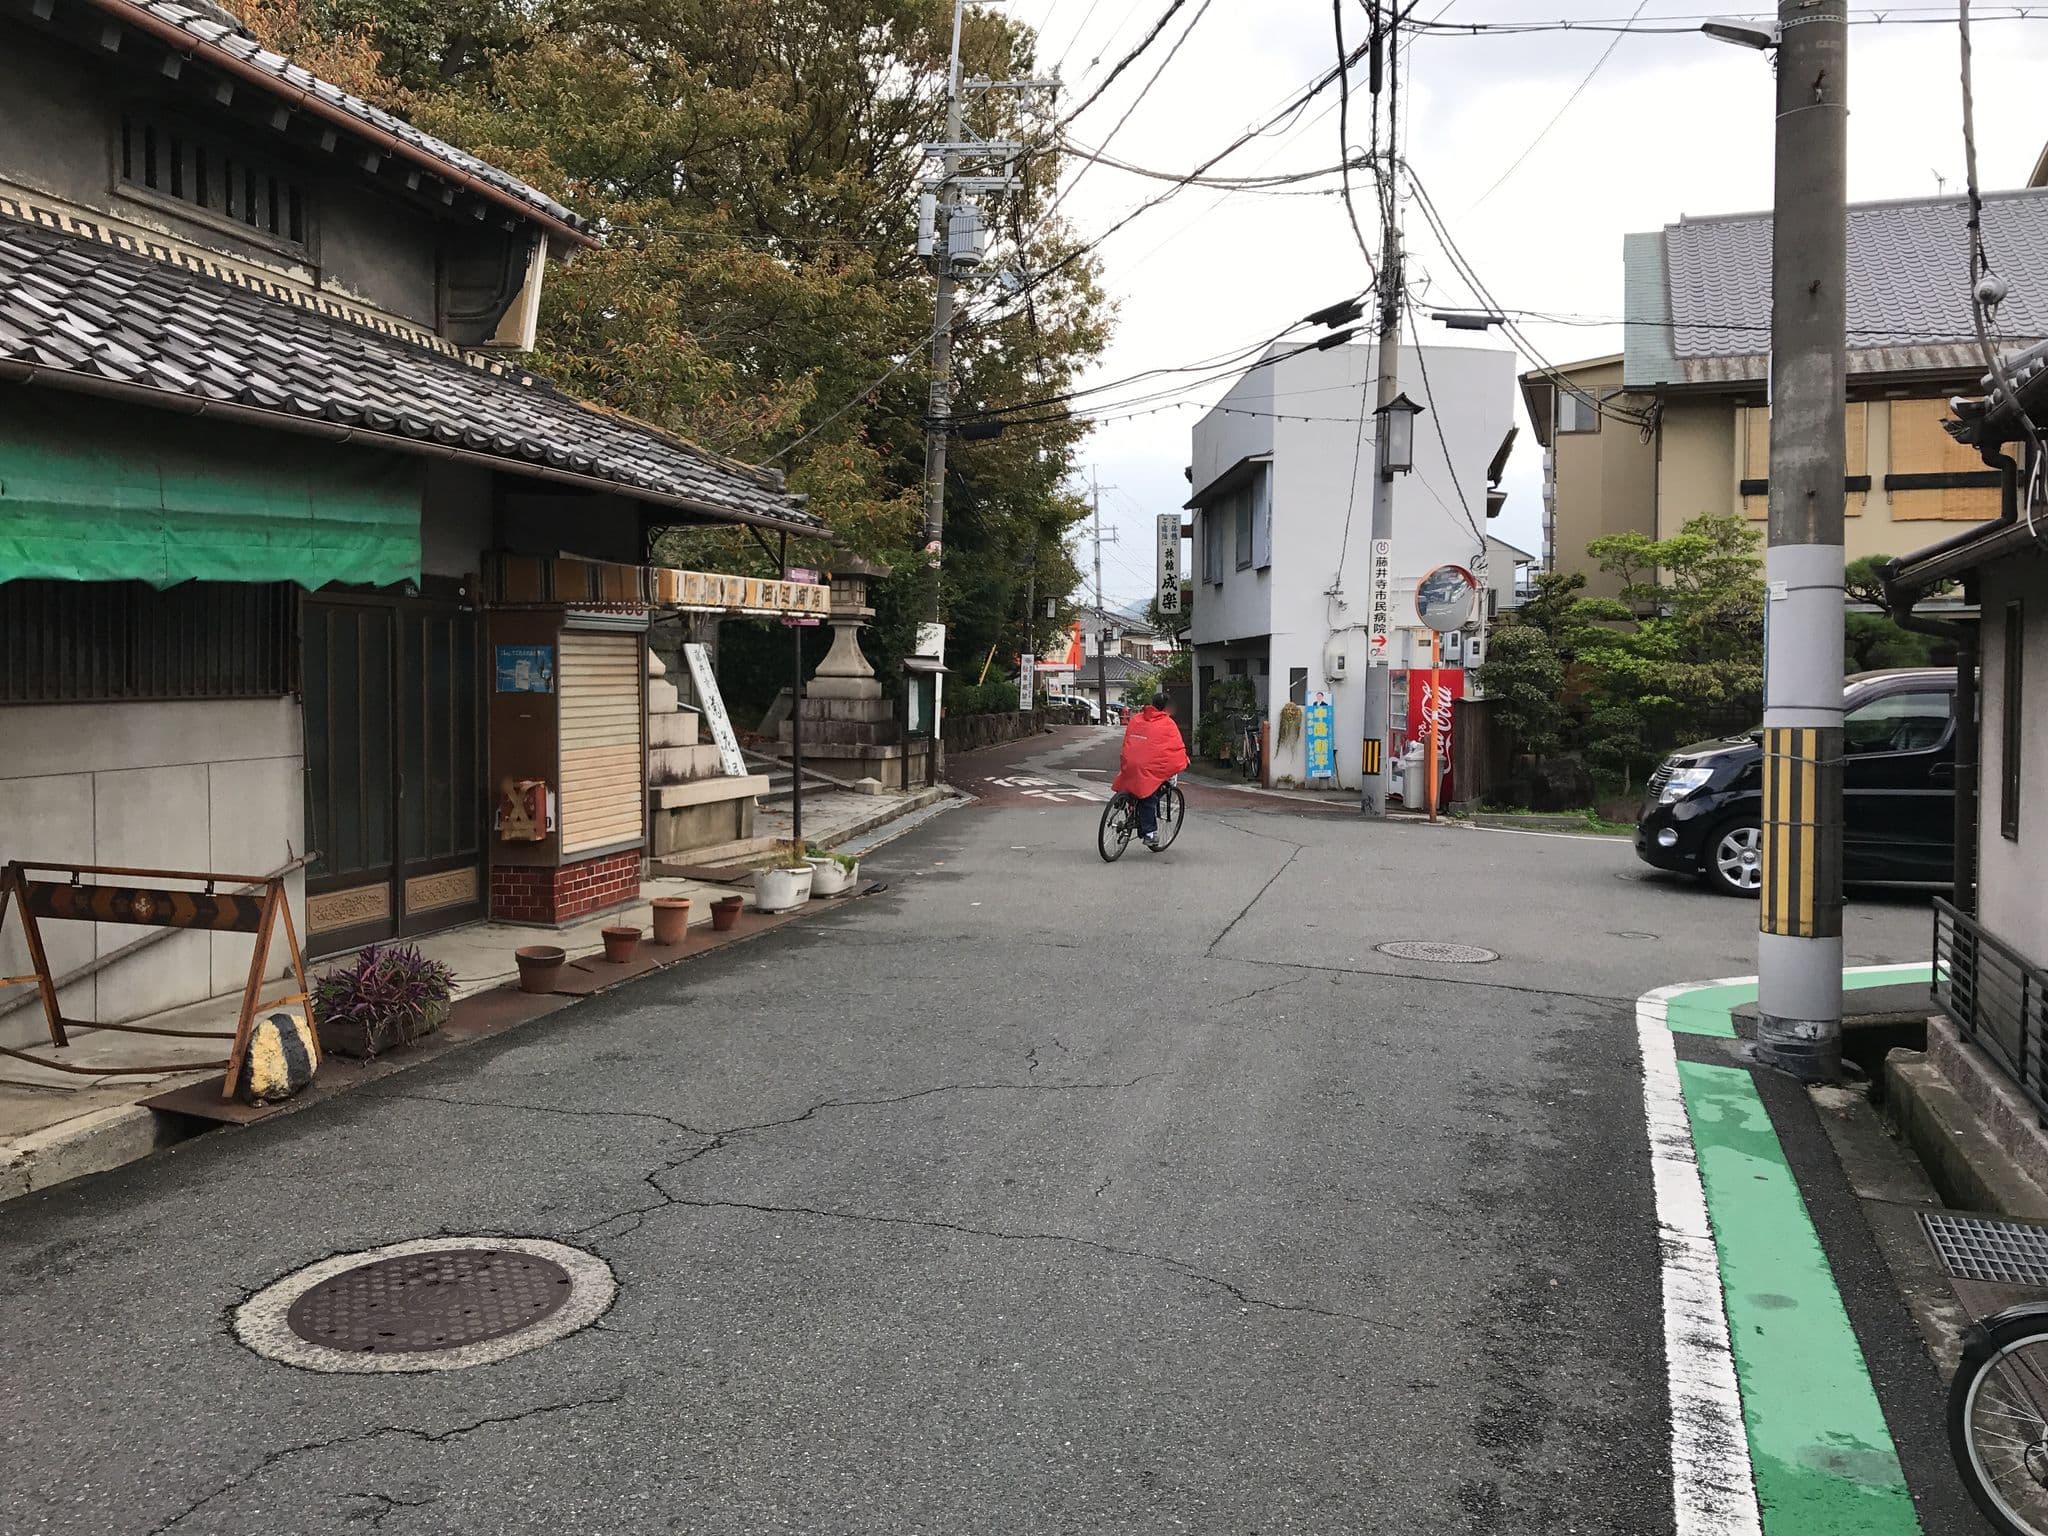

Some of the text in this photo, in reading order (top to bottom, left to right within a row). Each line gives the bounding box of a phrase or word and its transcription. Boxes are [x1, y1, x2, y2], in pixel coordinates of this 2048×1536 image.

[1373, 556, 1389, 634] 藤井寺市民病院
